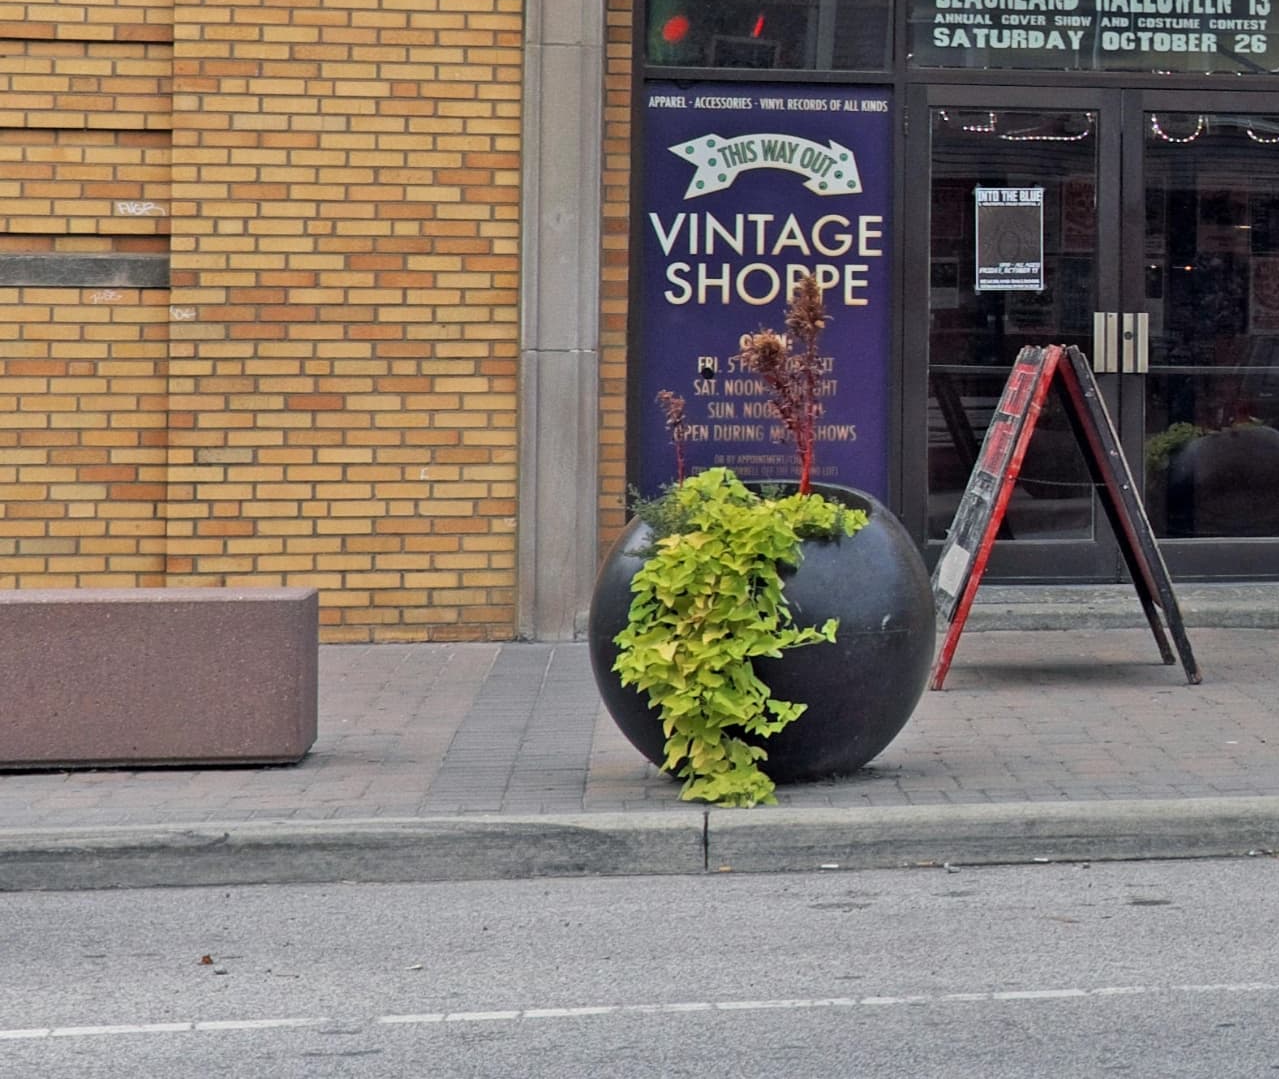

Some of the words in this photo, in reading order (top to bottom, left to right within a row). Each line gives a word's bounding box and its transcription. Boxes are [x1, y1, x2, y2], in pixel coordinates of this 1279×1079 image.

[934, 13, 993, 25] ANNUAL
[1001, 14, 1046, 26] COVER
[1054, 15, 1092, 27] SHOW
[1101, 17, 1129, 28] AND
[1138, 18, 1200, 29] COSTUME
[1209, 19, 1267, 31] CONTEST
[933, 27, 1085, 50] SATURDAY
[1102, 31, 1217, 53] OCTOBER
[1234, 33, 1267, 54] 26
[648, 96, 687, 108] APPAREL
[694, 97, 752, 109] ACCESSORIES
[760, 98, 785, 110] VINYL
[787, 98, 827, 111] RECORDS
[829, 99, 842, 111] OF
[843, 99, 859, 111] ALL
[861, 100, 888, 112] KINDS
[717, 139, 757, 168] THIS
[760, 139, 799, 164] WAY
[800, 147, 838, 178] OUT
[978, 190, 1000, 202] INTO
[1001, 190, 1018, 202] THE
[649, 211, 883, 257] VINTAGE
[664, 262, 869, 305] SHOPPE
[694, 380, 719, 397] SAT.
[708, 402, 738, 419] SUN.
[714, 424, 764, 441] DURING
[812, 425, 857, 441] SHOWS
